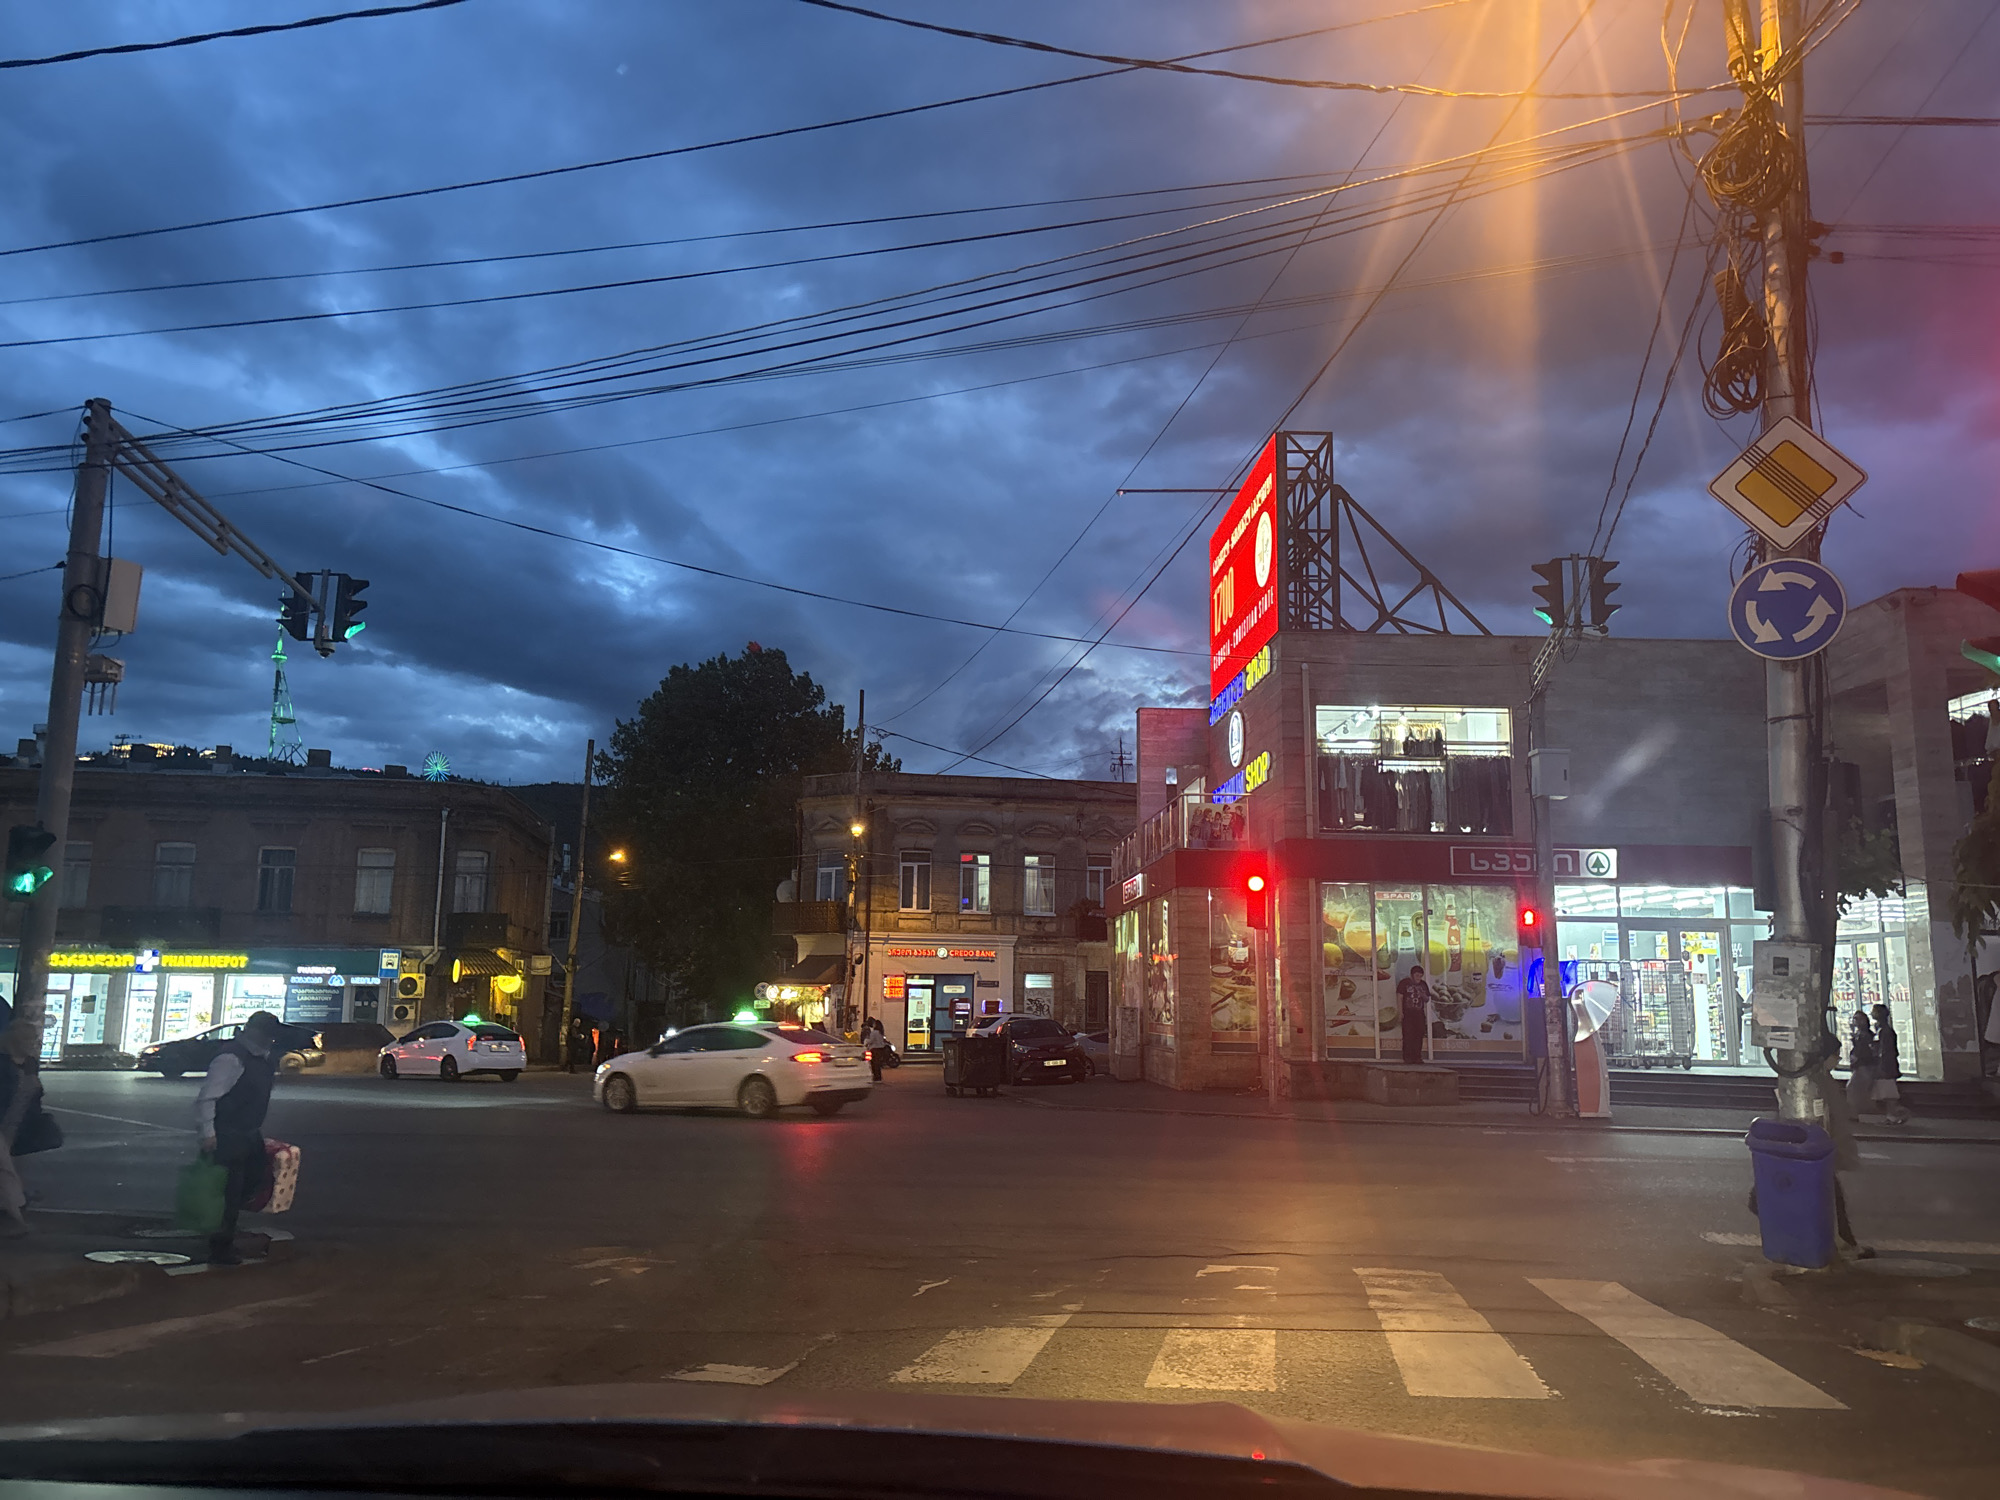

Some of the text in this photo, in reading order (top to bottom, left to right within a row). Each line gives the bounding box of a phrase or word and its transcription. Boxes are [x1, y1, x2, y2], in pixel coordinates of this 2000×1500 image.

[1213, 567, 1234, 637] 1700
[1233, 605, 1258, 649] CHRISTIAN
[1258, 585, 1274, 619] STATE
[1246, 751, 1271, 792] SHOP
[1470, 852, 1573, 873] სპაი
[161, 955, 249, 968] PHARMADEPOT
